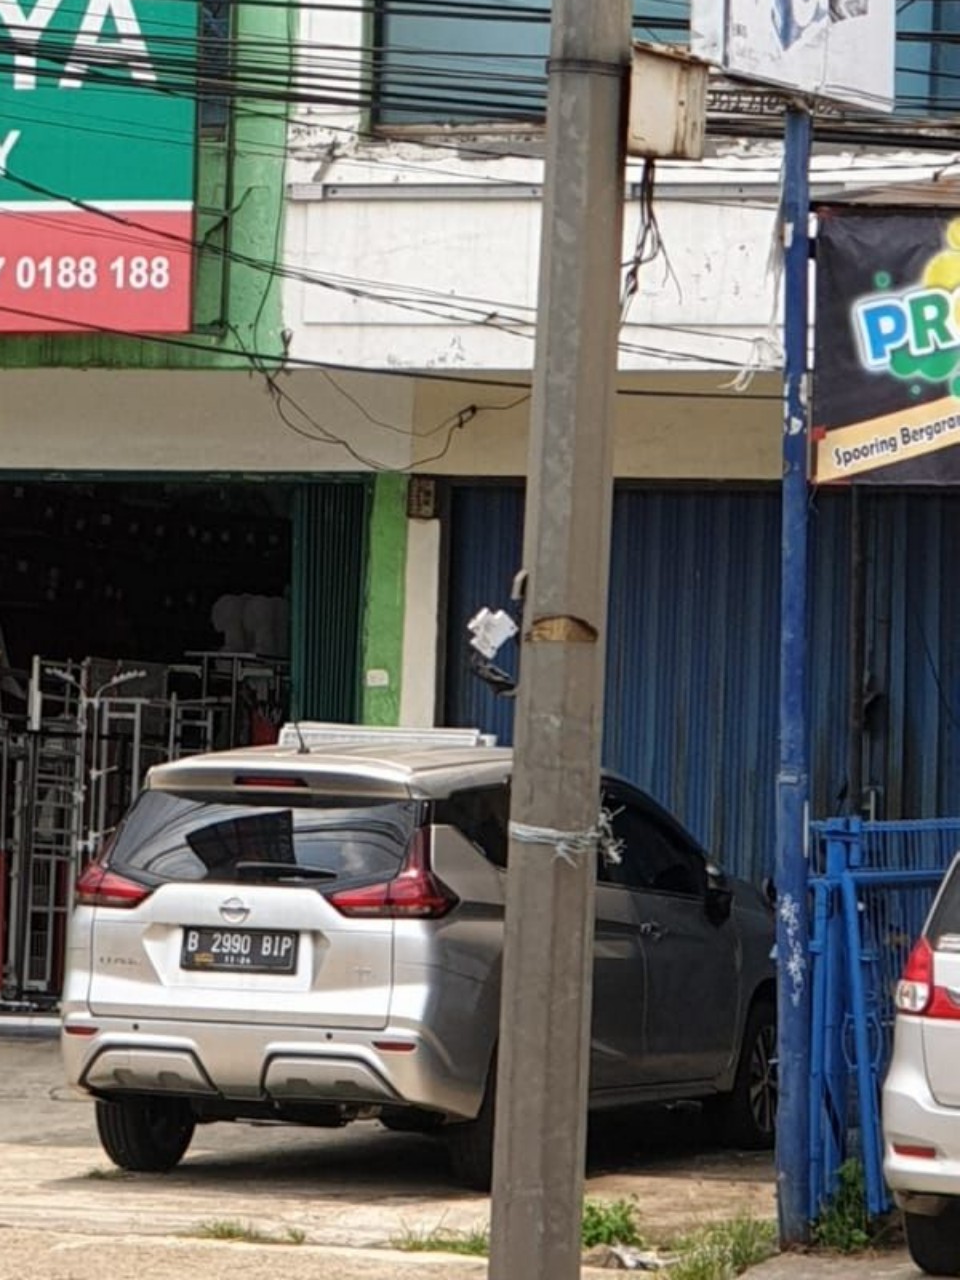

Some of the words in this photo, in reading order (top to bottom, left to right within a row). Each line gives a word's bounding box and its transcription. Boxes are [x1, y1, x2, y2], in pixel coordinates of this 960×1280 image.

[17, 256, 97, 290] 0188
[110, 256, 171, 290] 188
[860, 291, 960, 362] PR
[834, 436, 897, 467] Spooring
[187, 930, 199, 952] B
[211, 933, 252, 955] 2990
[261, 935, 292, 958] BIP
